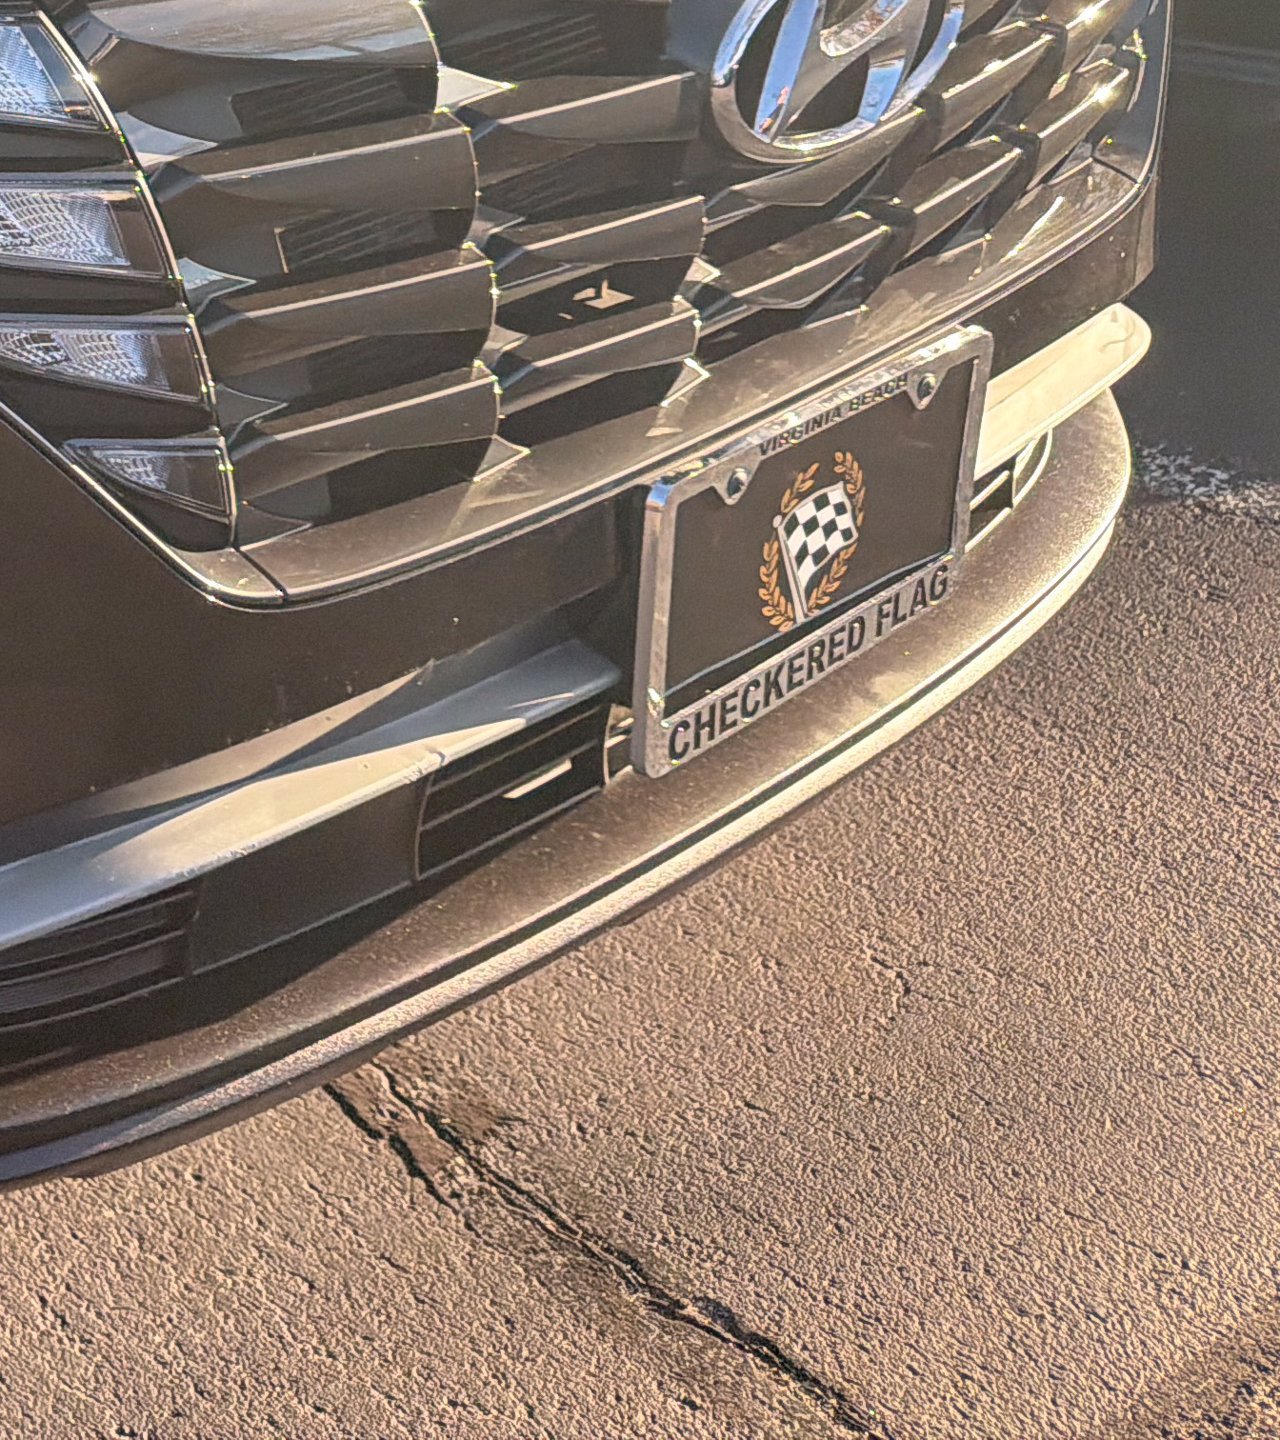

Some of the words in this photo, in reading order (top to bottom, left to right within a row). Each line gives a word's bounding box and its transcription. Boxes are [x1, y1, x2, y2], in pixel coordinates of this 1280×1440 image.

[758, 407, 844, 457] VIRGINIA
[848, 372, 909, 413] BEACH
[668, 613, 866, 762] CHECKERED
[874, 562, 950, 639] FLAG
